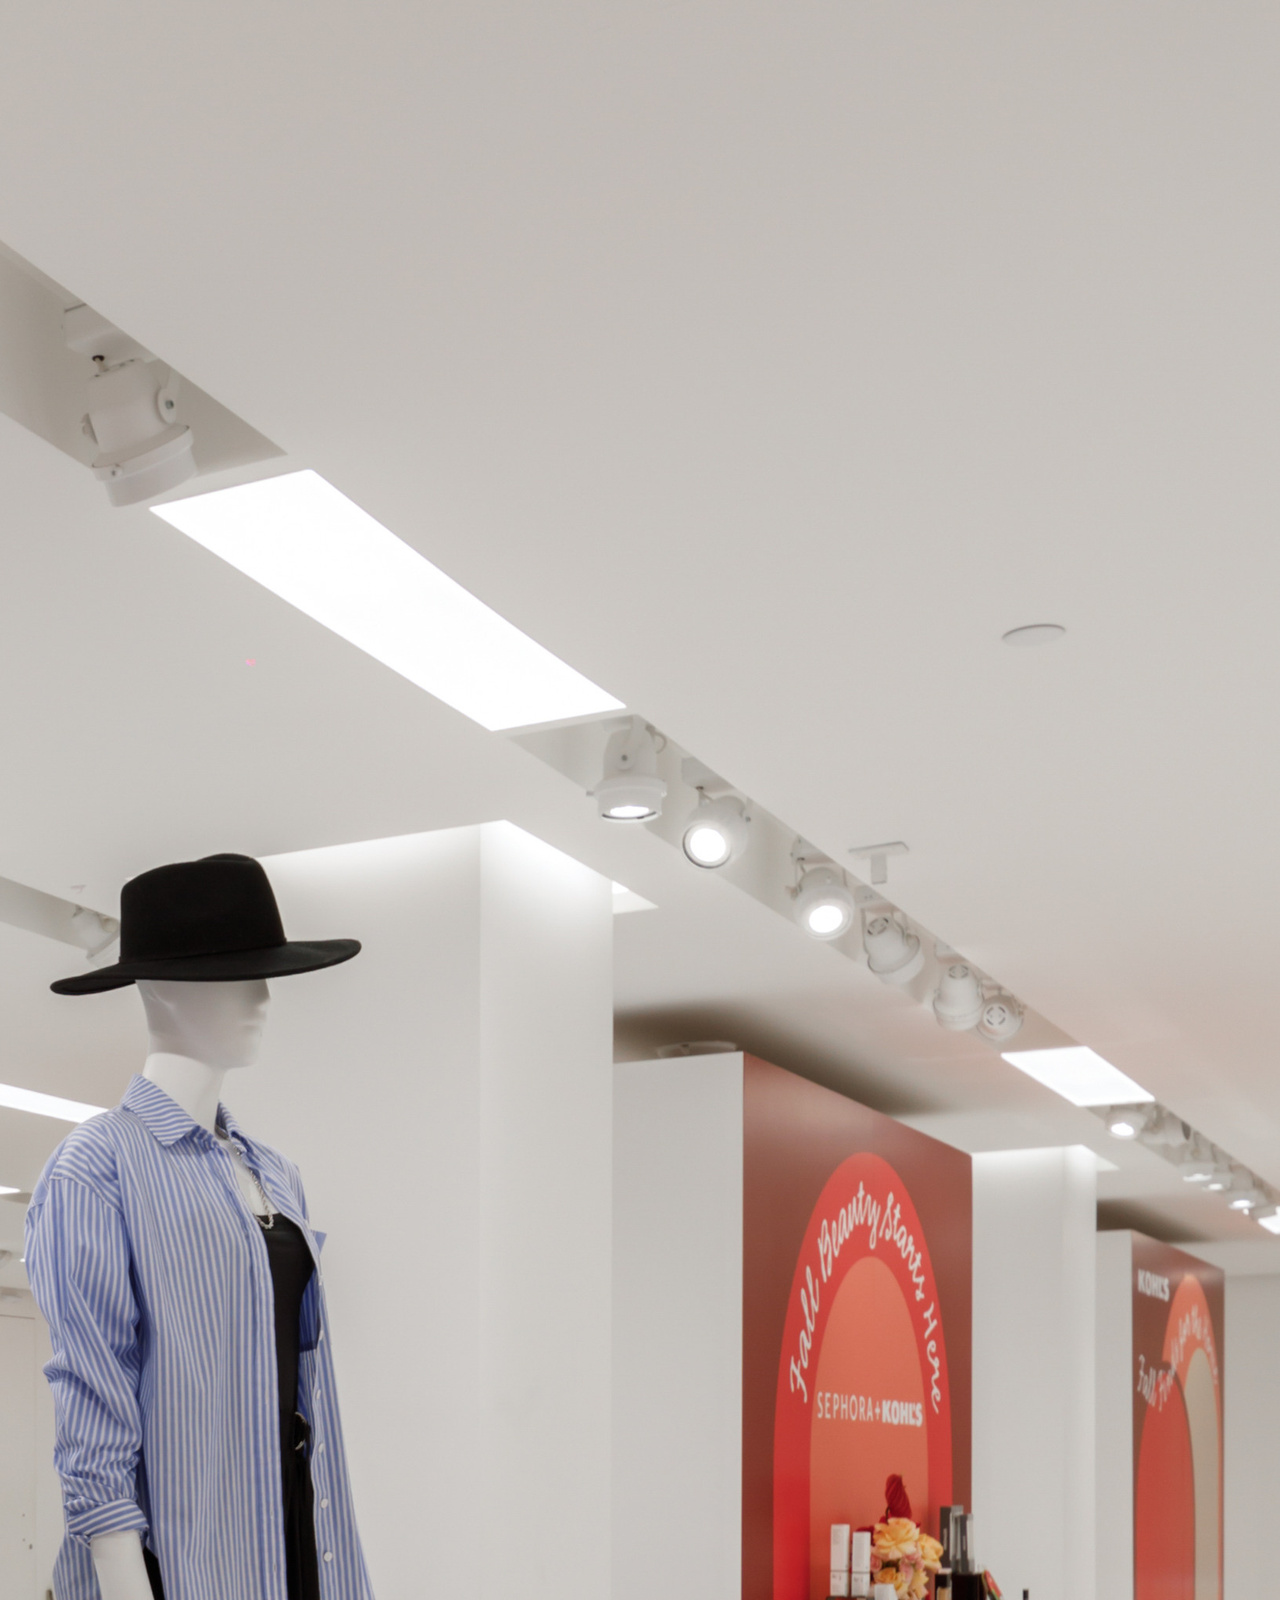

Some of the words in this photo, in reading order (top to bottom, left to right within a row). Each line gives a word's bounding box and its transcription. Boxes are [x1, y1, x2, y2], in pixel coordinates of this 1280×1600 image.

[789, 1265, 819, 1403] Fall
[817, 1180, 881, 1283] Beauty
[879, 1191, 925, 1302] Starts
[923, 1300, 940, 1415] Here
